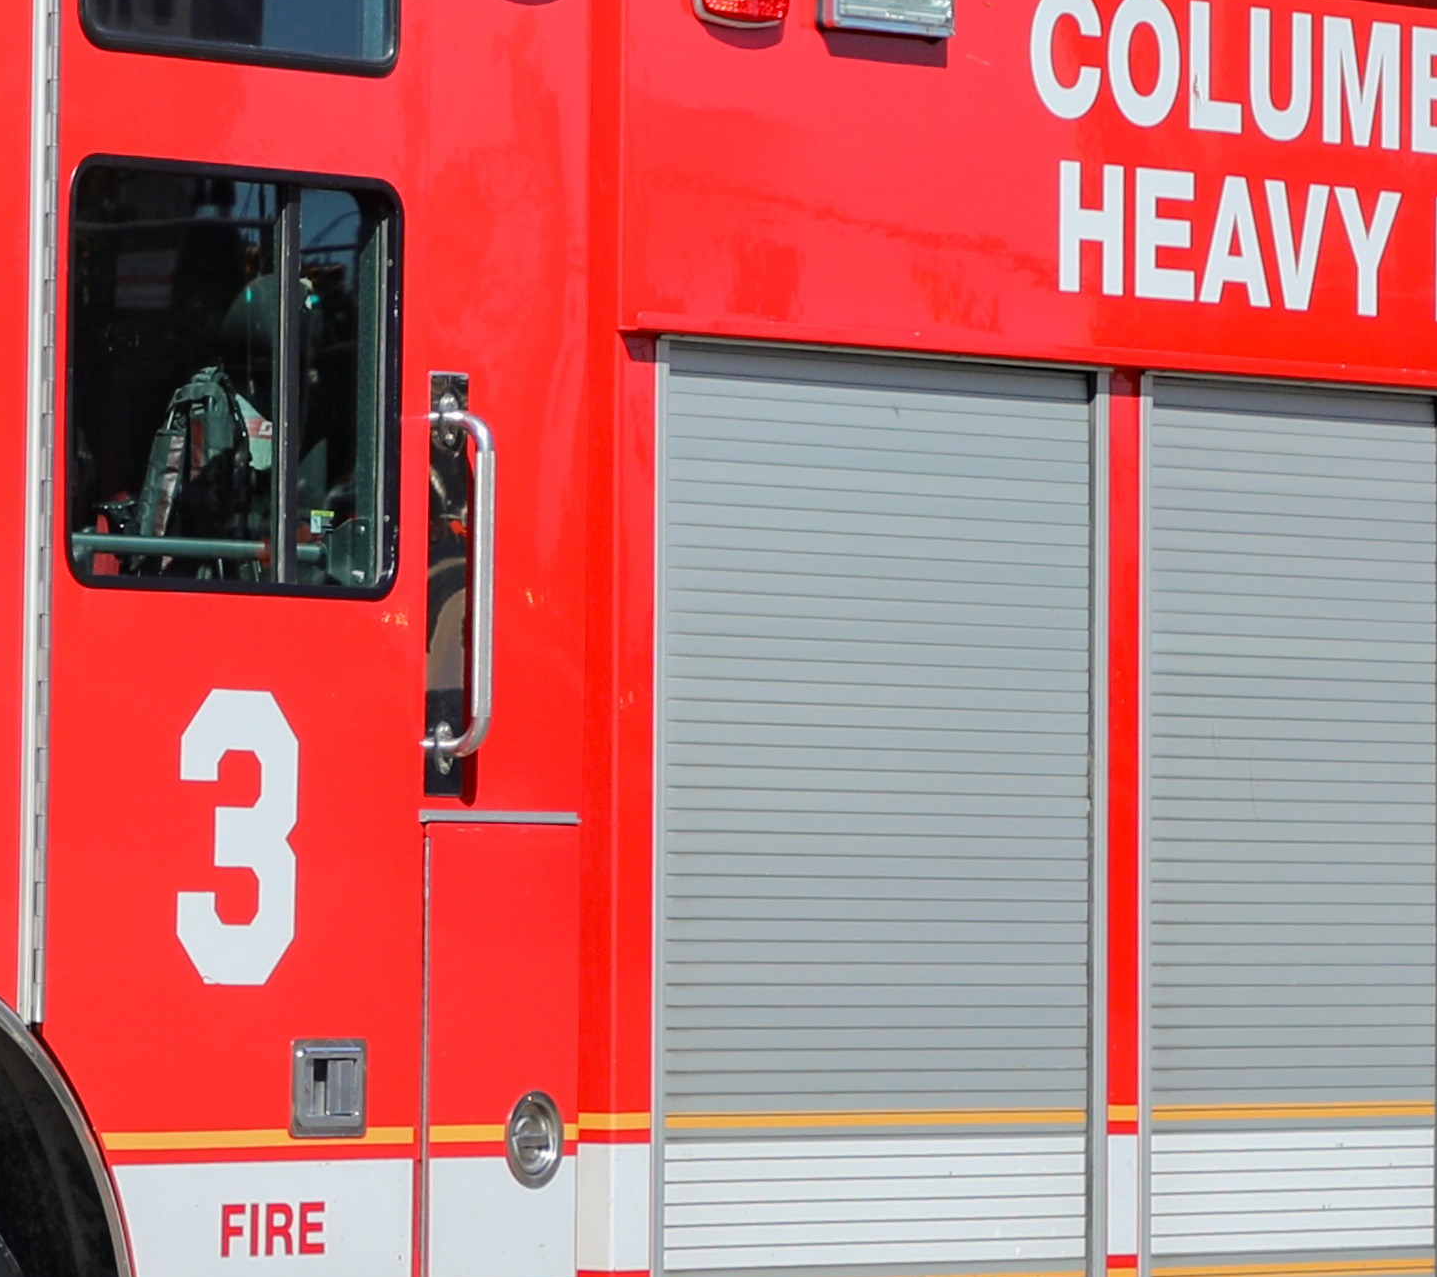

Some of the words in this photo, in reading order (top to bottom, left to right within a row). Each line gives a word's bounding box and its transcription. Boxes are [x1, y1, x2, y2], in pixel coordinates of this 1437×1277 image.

[1058, 160, 1402, 317] HEAVY
[175, 688, 300, 986] 3
[220, 1201, 326, 1258] FIRE
